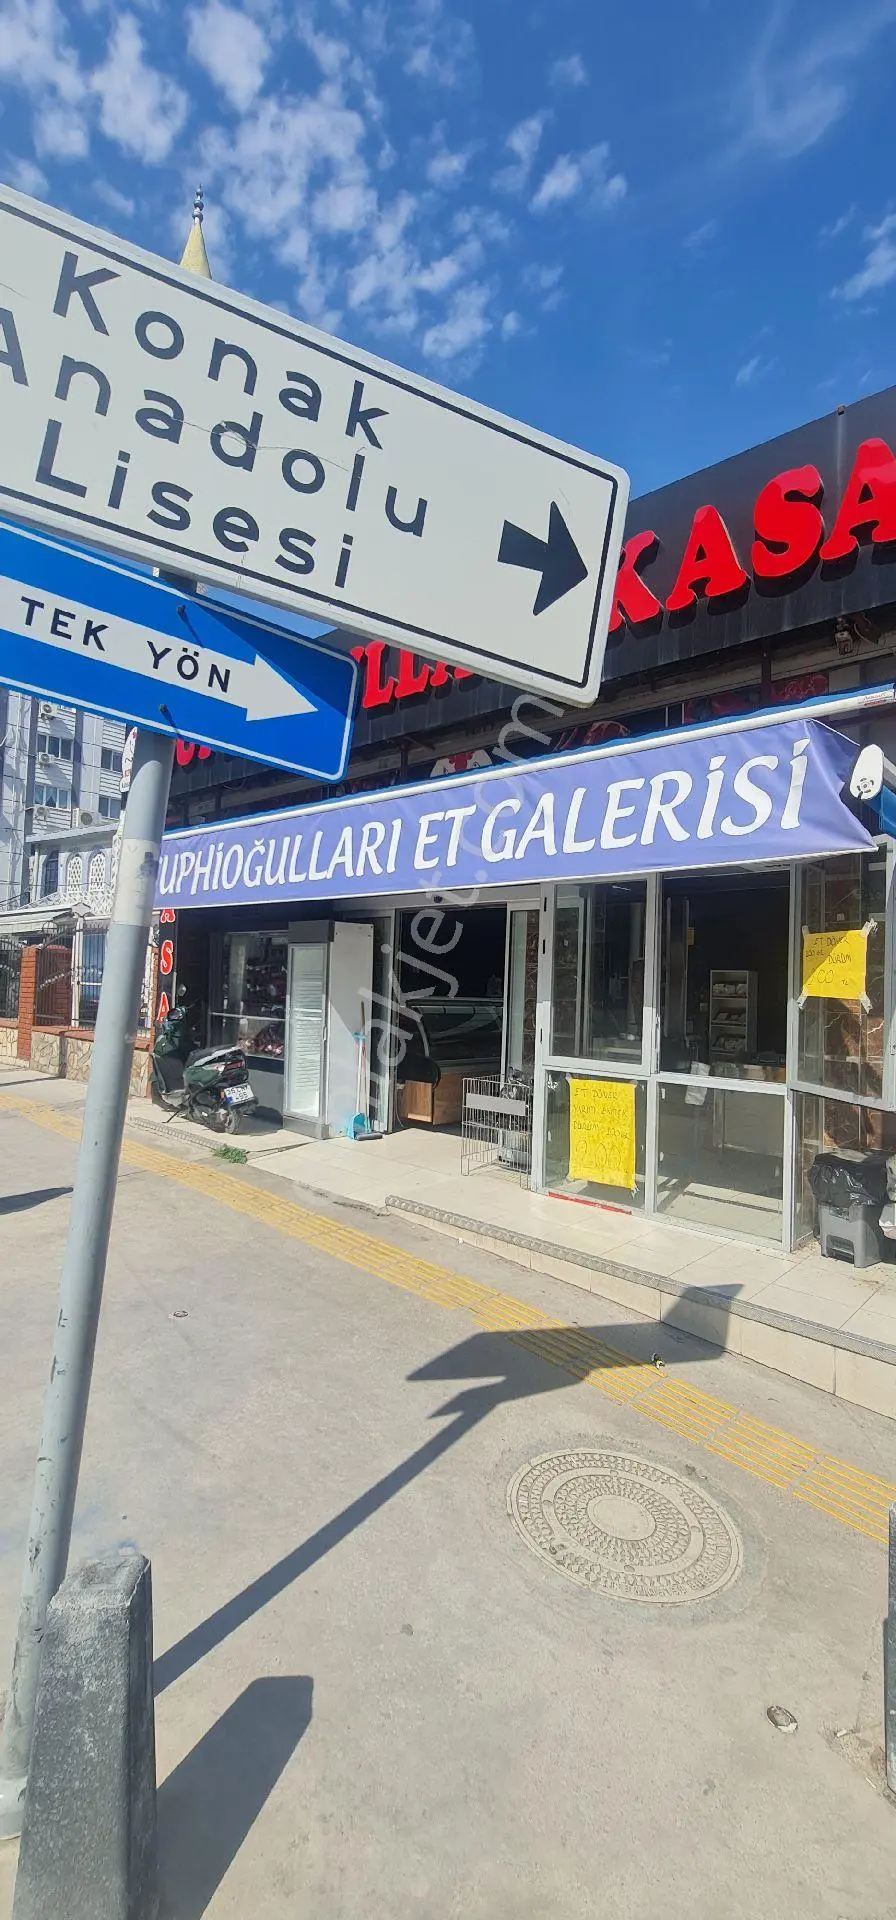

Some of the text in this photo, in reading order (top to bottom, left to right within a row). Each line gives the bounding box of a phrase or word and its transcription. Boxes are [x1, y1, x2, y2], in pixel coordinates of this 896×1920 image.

[0, 307, 429, 538] Anadolu
[53, 251, 390, 450] Konak
[35, 419, 354, 589] Lisesi
[20, 595, 231, 693] TEK YÖN
[158, 738, 811, 898] UPHİOĞULLARI ET GALERİSİ
